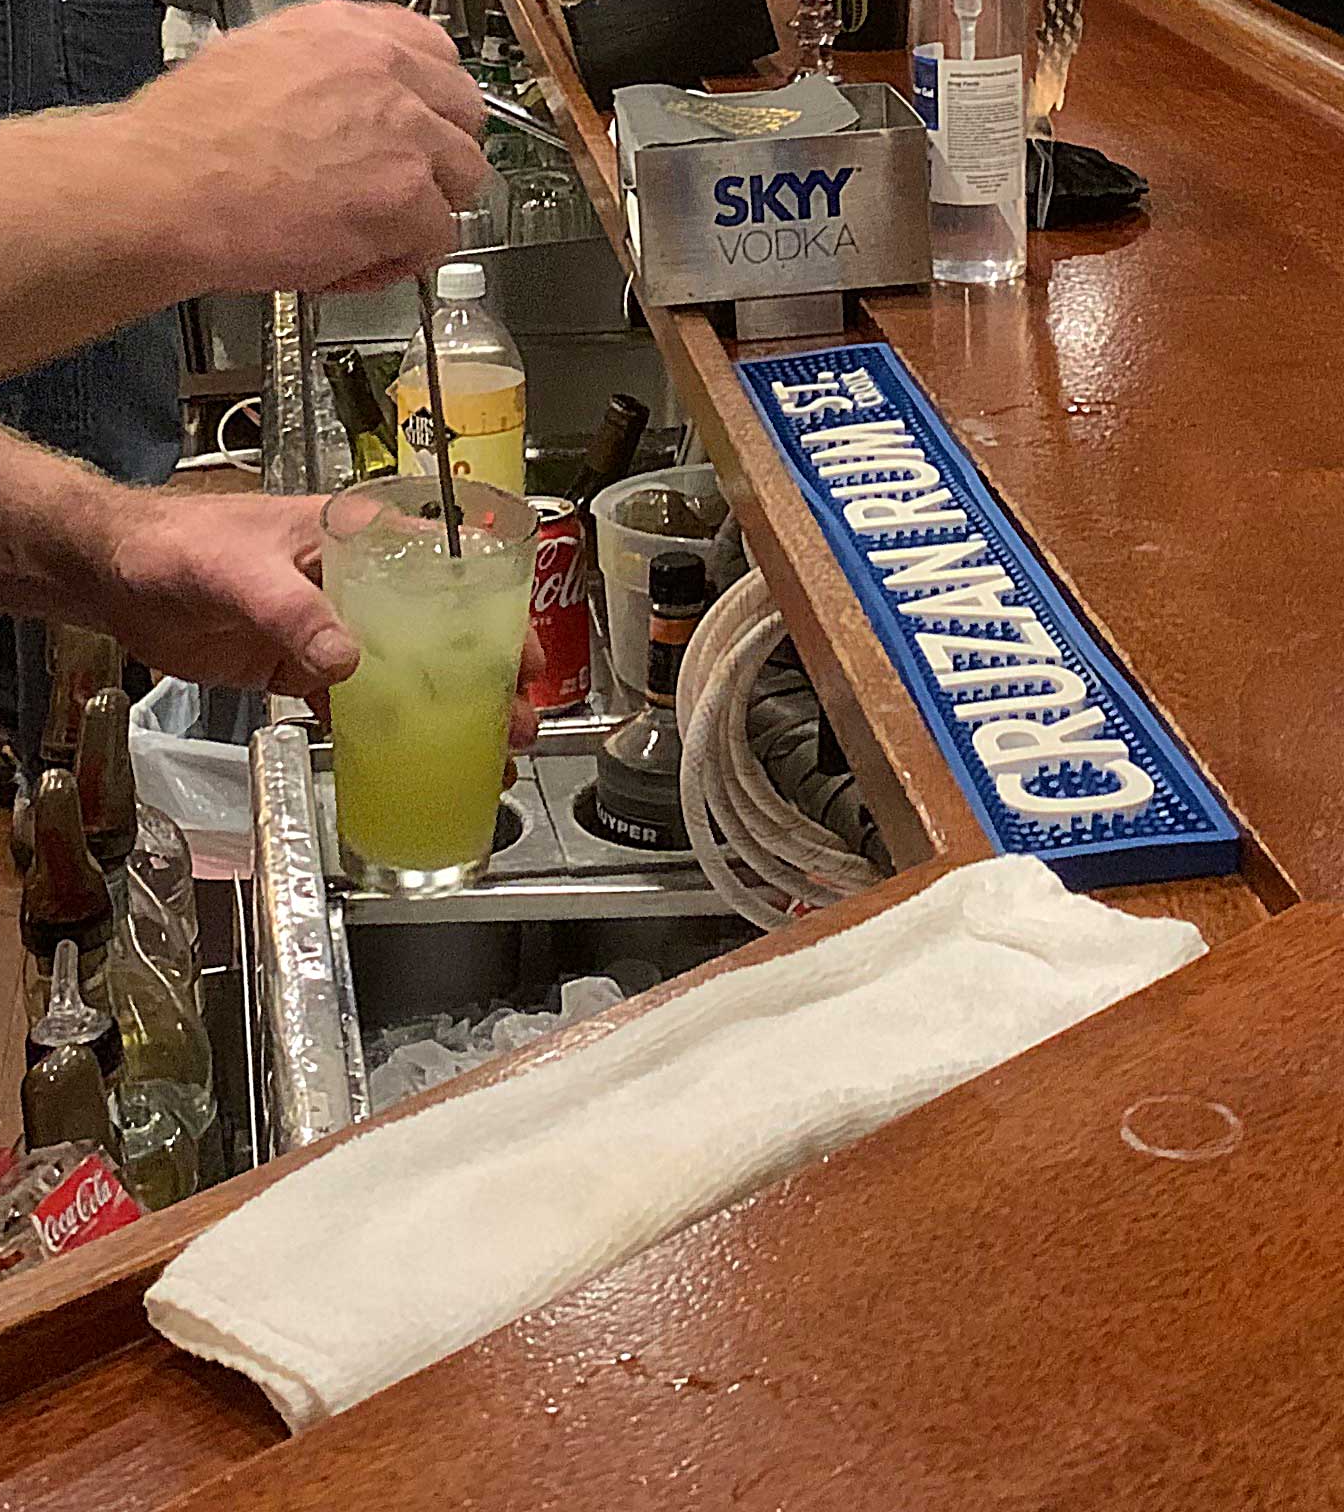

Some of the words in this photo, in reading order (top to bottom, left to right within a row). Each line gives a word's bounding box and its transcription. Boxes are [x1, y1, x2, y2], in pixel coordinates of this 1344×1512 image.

[713, 167, 855, 227] SKYY
[716, 223, 860, 265] VODKA
[800, 420, 967, 538] RUM
[867, 540, 1155, 818] CRUZAN
